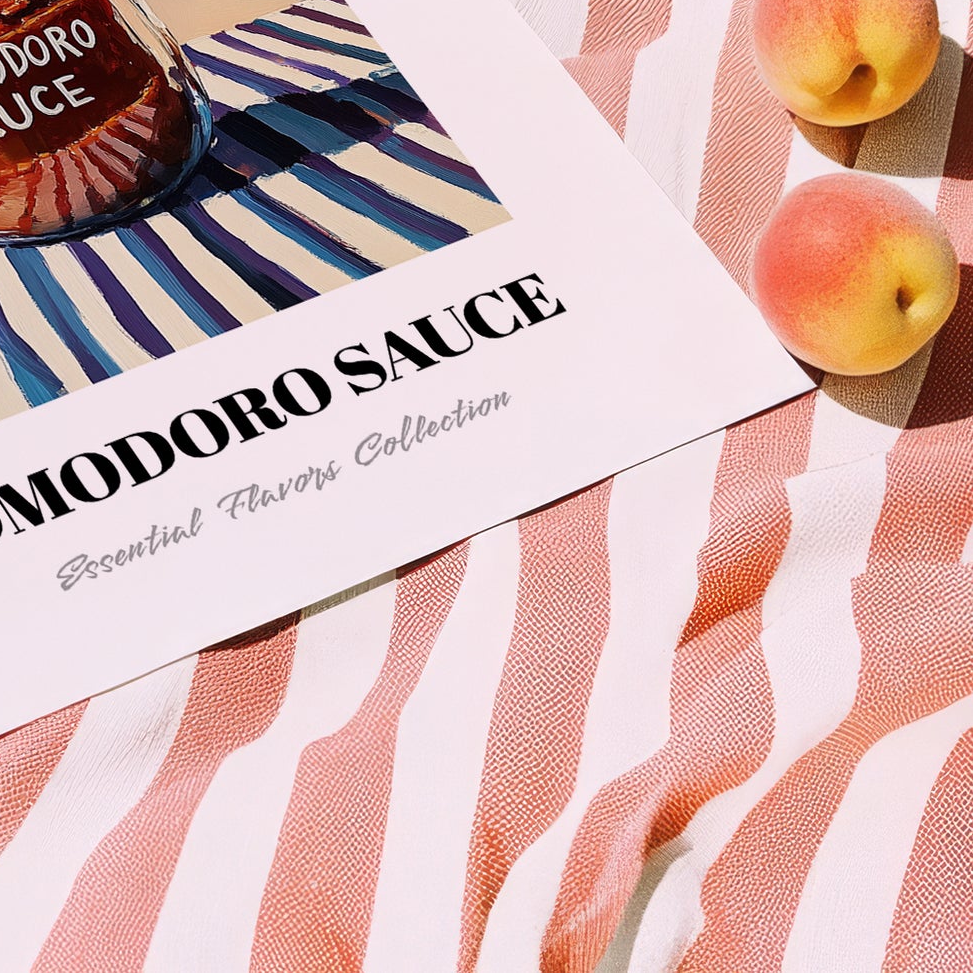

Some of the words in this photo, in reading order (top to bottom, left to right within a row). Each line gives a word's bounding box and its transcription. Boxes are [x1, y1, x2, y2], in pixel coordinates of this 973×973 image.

[333, 272, 567, 397] SAUCE
[56, 507, 203, 591] Essential
[217, 456, 342, 520] Flavors
[354, 388, 512, 467] Collection
